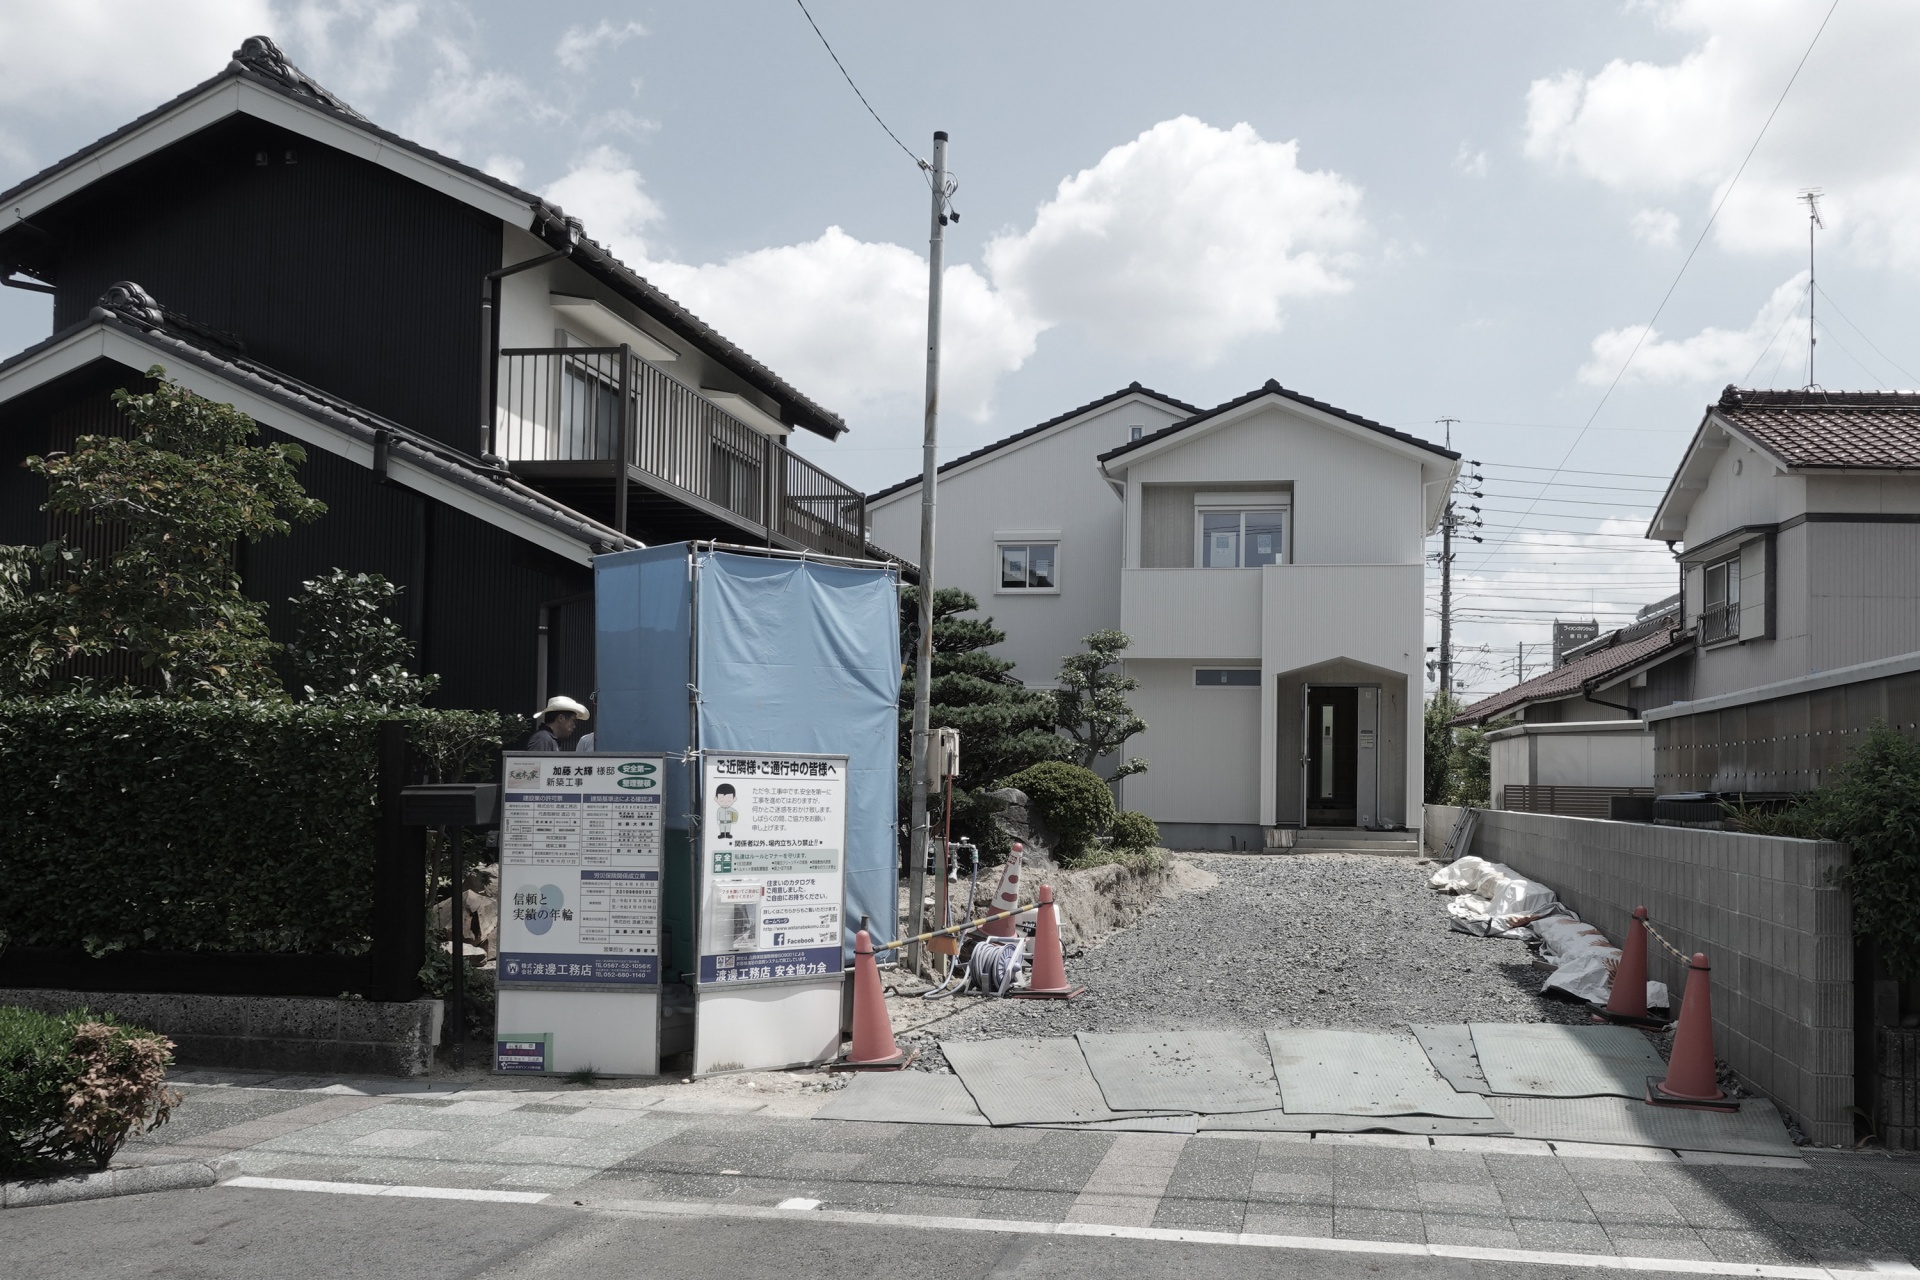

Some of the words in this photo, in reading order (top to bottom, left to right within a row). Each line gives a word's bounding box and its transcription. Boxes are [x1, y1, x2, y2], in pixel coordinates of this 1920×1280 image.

[552, 766, 571, 776] 加藤
[574, 766, 593, 776] 大輝
[596, 766, 615, 776] 様邸
[622, 764, 652, 773] 安全第一
[716, 759, 837, 776] ご近隣様・ご通行中の皆様へ
[546, 777, 583, 787] 新築工事
[766, 879, 816, 887] 住まいのカタログを
[766, 886, 806, 894] ご用意しました。
[513, 892, 547, 905] 信頼と
[766, 893, 828, 902] ご自由にお持ちください。
[513, 908, 573, 921] 実績の年輪
[787, 937, 815, 945] Facebook
[533, 963, 593, 977] 渡邊工務店
[715, 965, 771, 982] 渡邊工務店
[774, 962, 828, 977] 安全協力会
